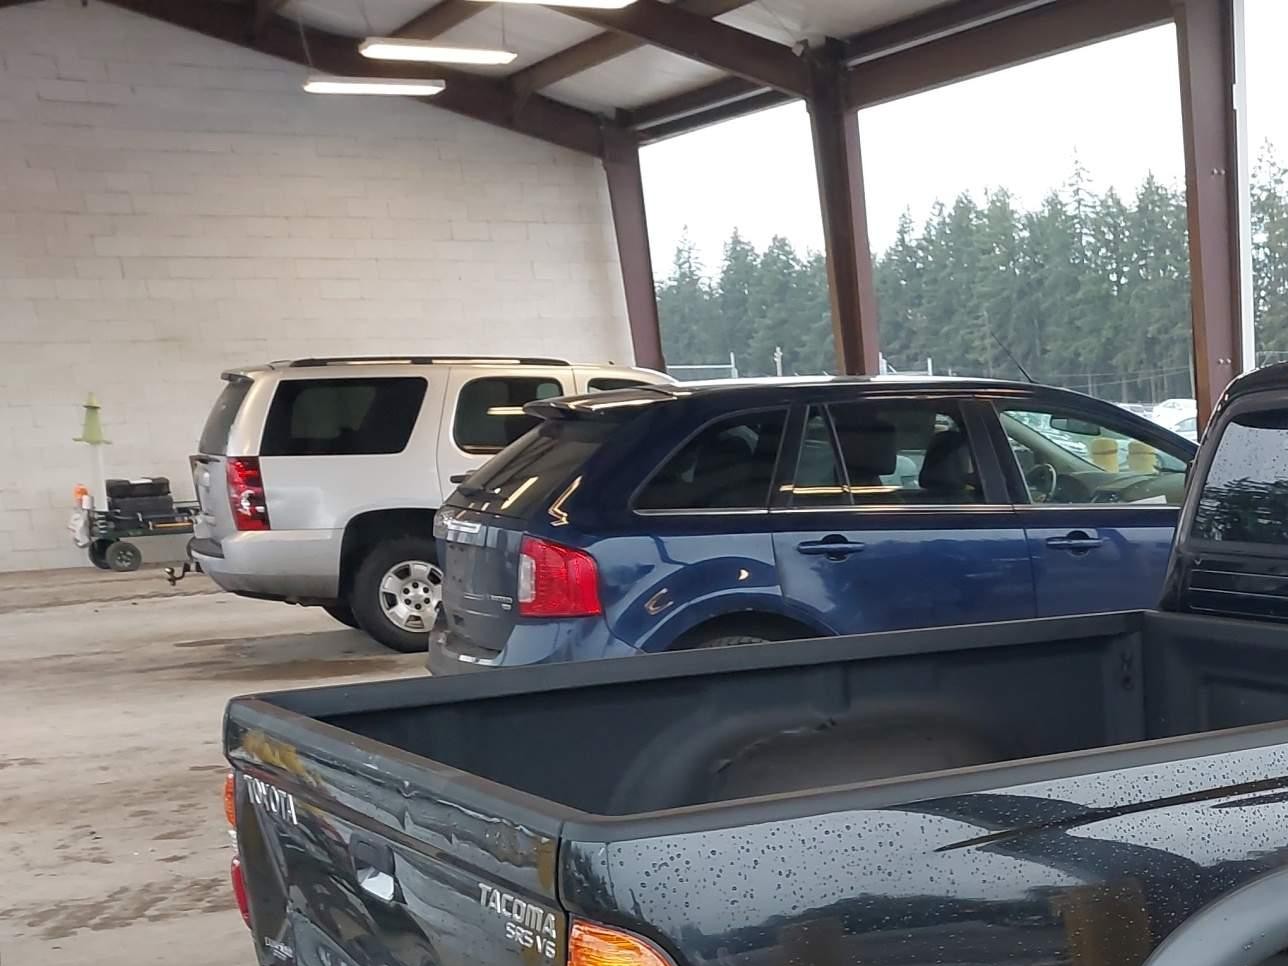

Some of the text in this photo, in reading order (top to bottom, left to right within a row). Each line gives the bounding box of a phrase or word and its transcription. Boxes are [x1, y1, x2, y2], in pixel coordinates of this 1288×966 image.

[243, 774, 298, 825] TOYOTA
[478, 882, 557, 939] TACOMA
[535, 935, 556, 959] V6
